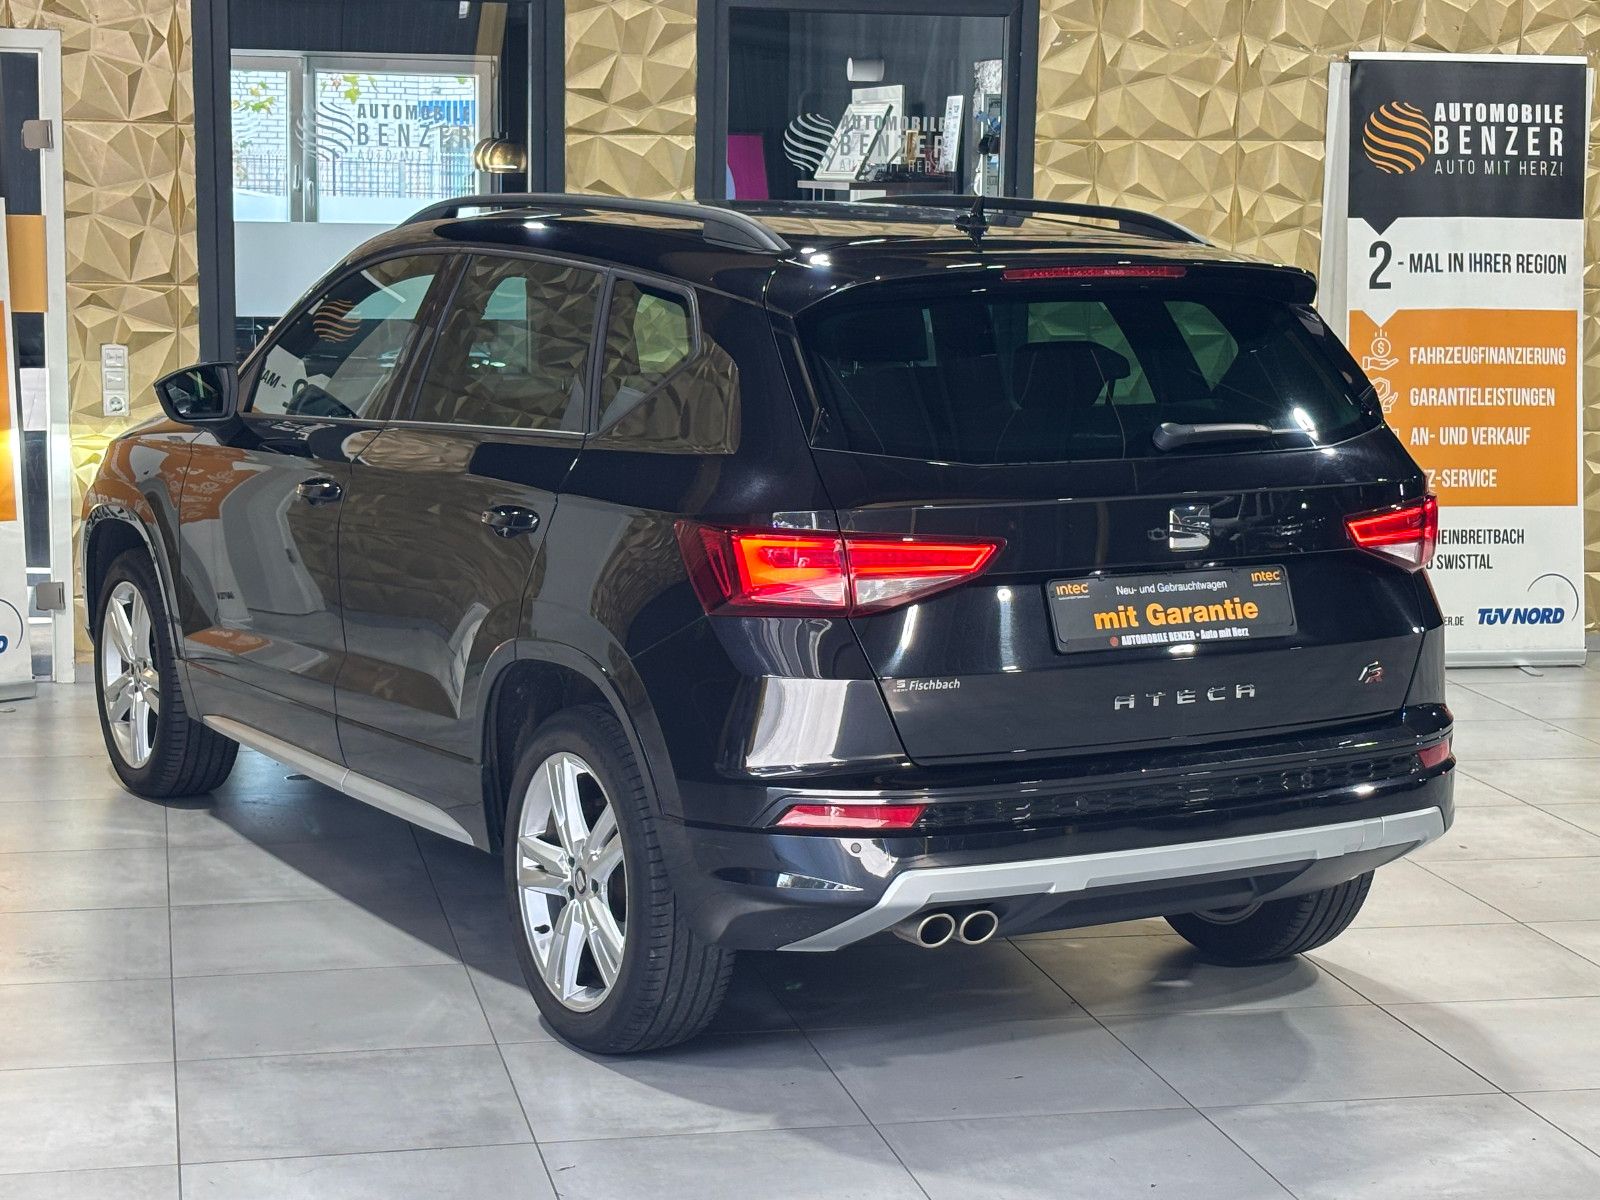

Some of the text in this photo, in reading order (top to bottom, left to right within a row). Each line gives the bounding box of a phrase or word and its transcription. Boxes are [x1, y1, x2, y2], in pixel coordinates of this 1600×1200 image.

[357, 103, 470, 124] AUTOMOBILE
[1434, 102, 1564, 124] AUTOMOBILE
[357, 122, 471, 149] BENZER
[1434, 125, 1564, 157] BENZER
[1434, 159, 1475, 175] AUTO
[1484, 160, 1511, 175] MIT
[1369, 240, 1393, 290] 2
[1409, 253, 1444, 274] MAL
[1448, 253, 1464, 273] IN
[1469, 253, 1512, 274] IHRER
[1516, 254, 1567, 275] REGION
[1409, 346, 1567, 366] FAHRZEUGFINANZIERUNG
[1409, 387, 1556, 407] GARANTIELEISTUNGEN
[1410, 427, 1532, 446] AN- UND VERKAUF
[1423, 468, 1498, 488] Z-SERVICE
[1436, 553, 1493, 570] SWISTTAL
[1056, 583, 1089, 595] intec
[1116, 579, 1228, 596] Neu- und Gebrauchtwagen
[1093, 596, 1260, 631] mit Garantie
[1512, 607, 1565, 625] NORD
[1121, 626, 1250, 646] AUTOMOBILE BENZER Auto mit Herz
[909, 678, 961, 691] Fischbach
[1114, 683, 1256, 711] ATECA
